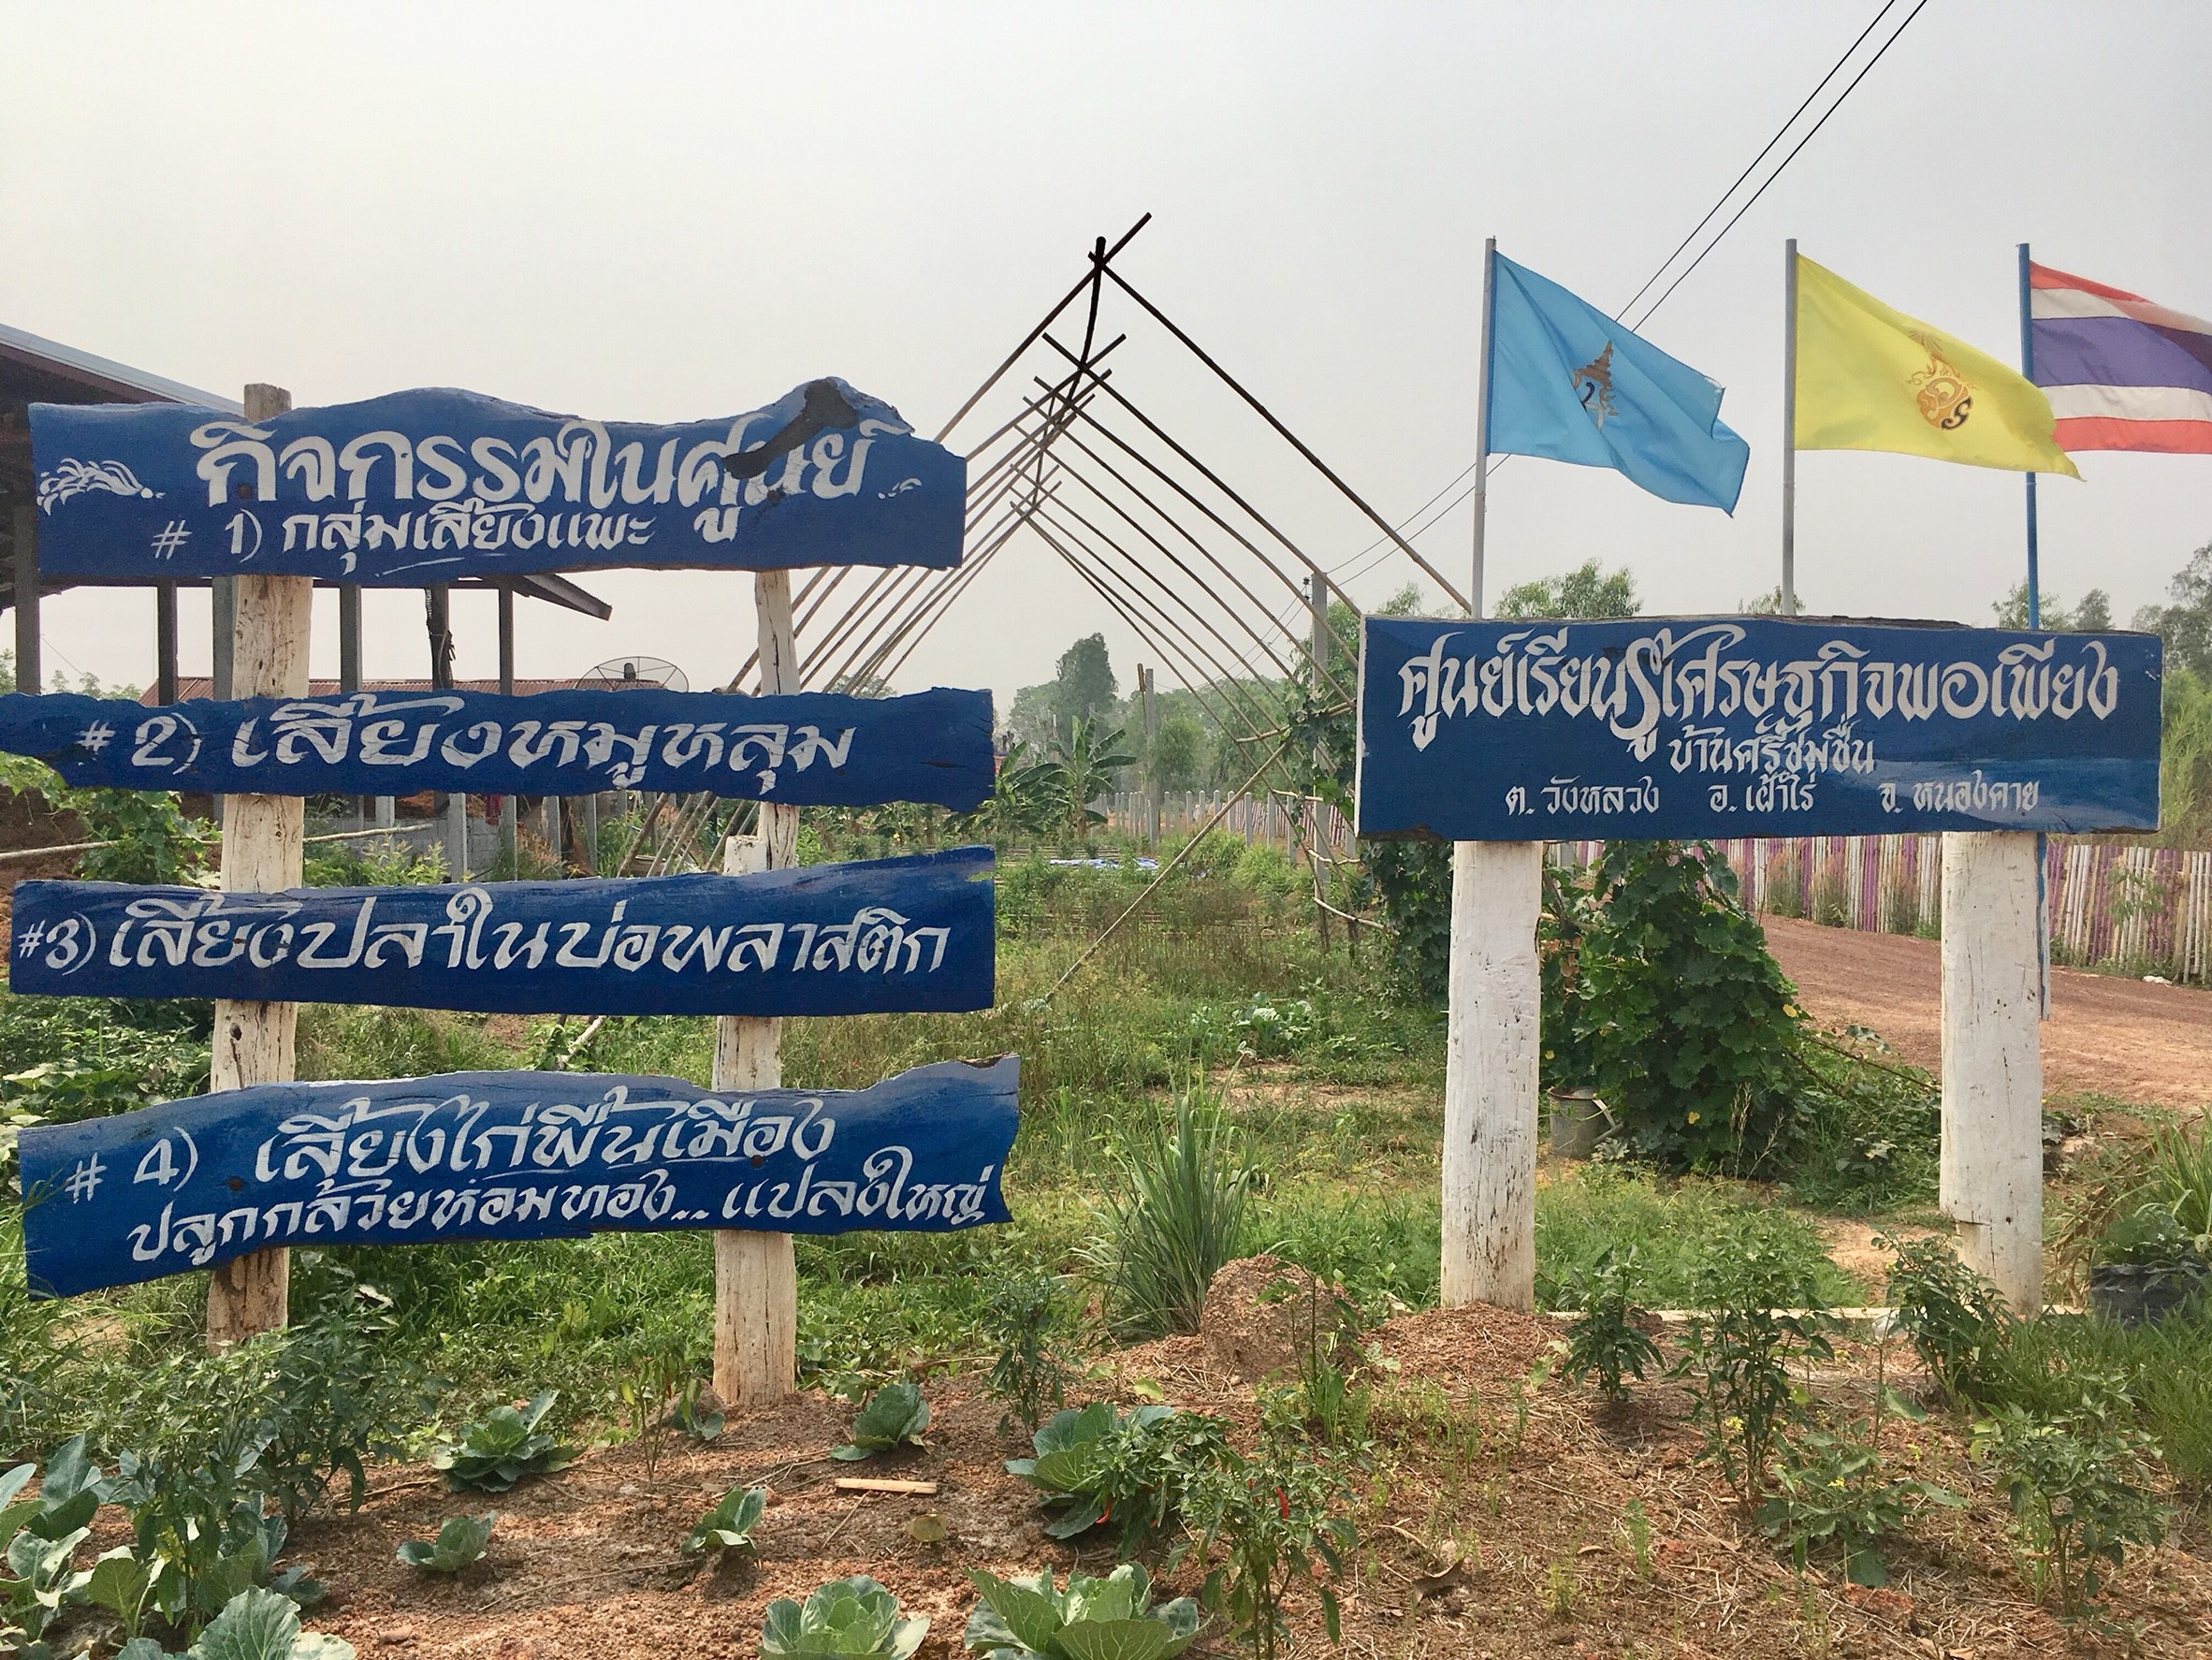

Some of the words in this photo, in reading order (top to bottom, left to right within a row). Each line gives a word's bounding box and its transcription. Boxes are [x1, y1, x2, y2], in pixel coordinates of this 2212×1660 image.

[226, 508, 263, 562] 1)
[282, 497, 657, 575] กลุ่มเลี้ยงแพะ
[1397, 623, 2120, 763] ศูนย์เรียนรู้เศรษฐกิจพอเพียง
[131, 712, 202, 776] 2)
[230, 692, 856, 795] เลี้ยงหมูหลุม
[1540, 775, 1660, 815] วังหลวง
[1913, 769, 2041, 814] หนองคาย
[109, 887, 951, 975] เลี้ยงปลาในบ่อพลาสติก
[133, 1126, 198, 1193] 4)
[255, 1085, 836, 1185] เลี้ยงไก่พื้นเมือง
